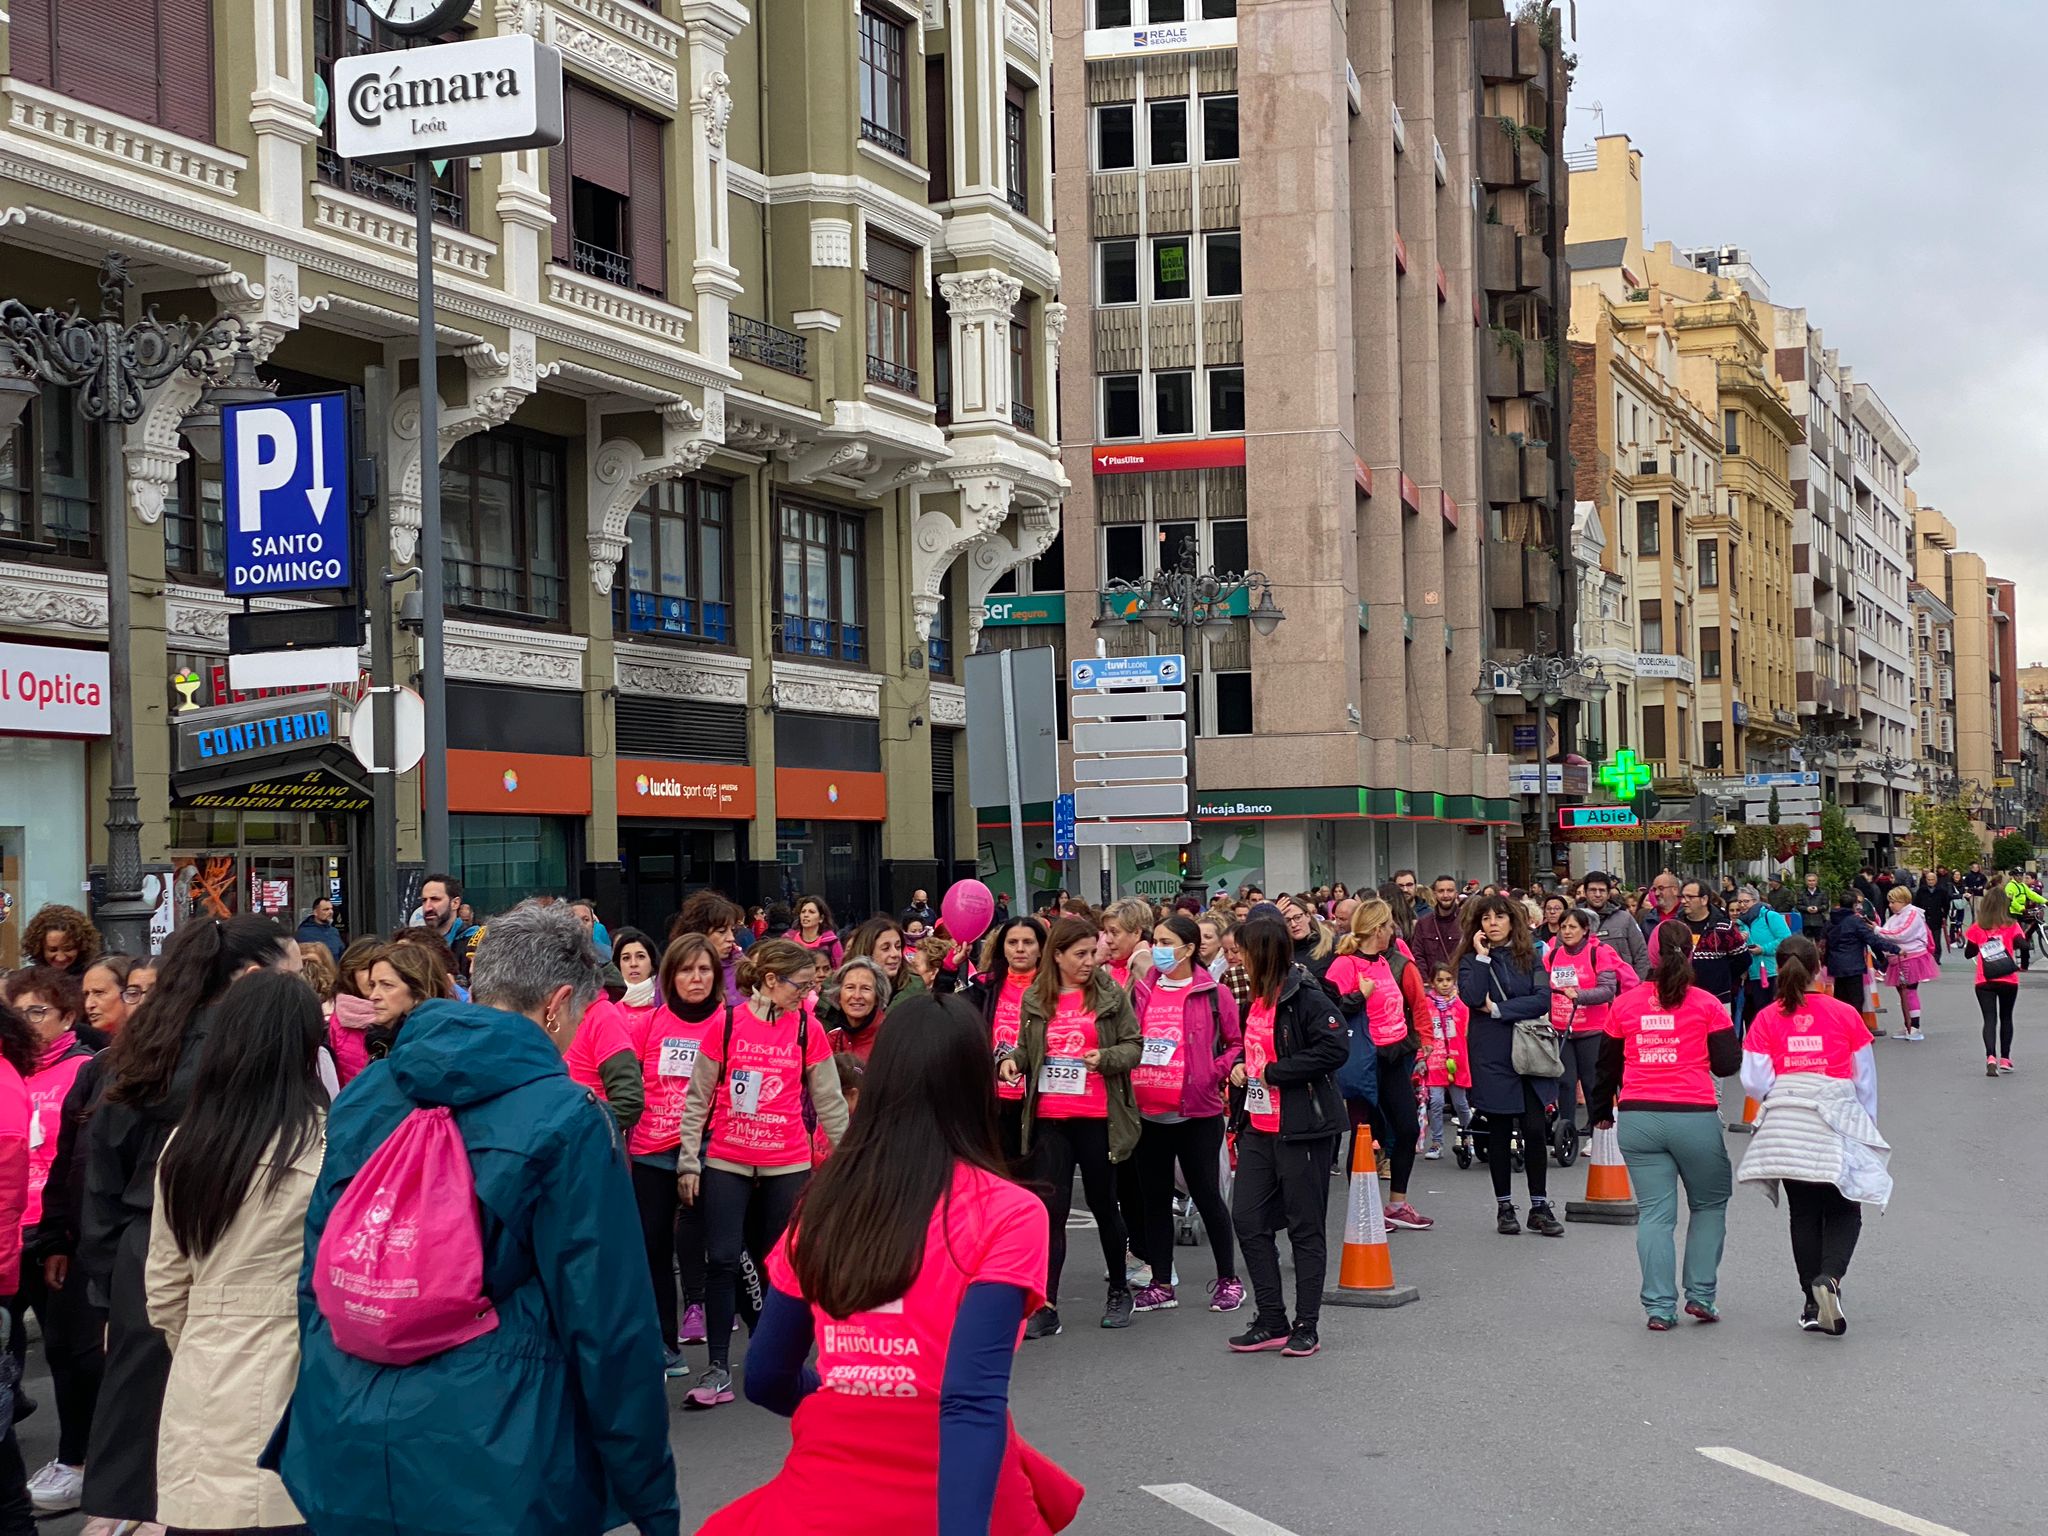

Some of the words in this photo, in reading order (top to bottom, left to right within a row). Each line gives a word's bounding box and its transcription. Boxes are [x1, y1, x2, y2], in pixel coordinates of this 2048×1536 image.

[1150, 28, 1187, 38] REALE
[1150, 37, 1187, 45] SEGUROS
[348, 66, 520, 126] Cámara
[411, 116, 448, 136] León
[1108, 456, 1144, 465] PlusUltra
[236, 407, 298, 532] P
[252, 533, 323, 557] SANTO
[235, 558, 341, 586] DOMINGO
[1012, 610, 1048, 621] seguros
[18, 671, 101, 711] Optica
[198, 710, 330, 758] CONFITERIA
[302, 772, 320, 783] EL
[248, 784, 350, 797] VALENCIANO
[650, 777, 681, 796] luckia
[683, 785, 701, 799] sport
[702, 783, 717, 800] café
[189, 796, 285, 809] HELADERIA
[1236, 803, 1273, 814] Banco
[1555, 970, 1576, 979] 3959
[736, 1038, 793, 1057] Drasanvi
[1639, 1053, 1678, 1063] ZAPICO
[1046, 1067, 1080, 1080] 3528
[735, 1119, 775, 1140] Mujer
[837, 1336, 920, 1356] HIJOLUSA
[827, 1365, 917, 1381] DESATASCOS
